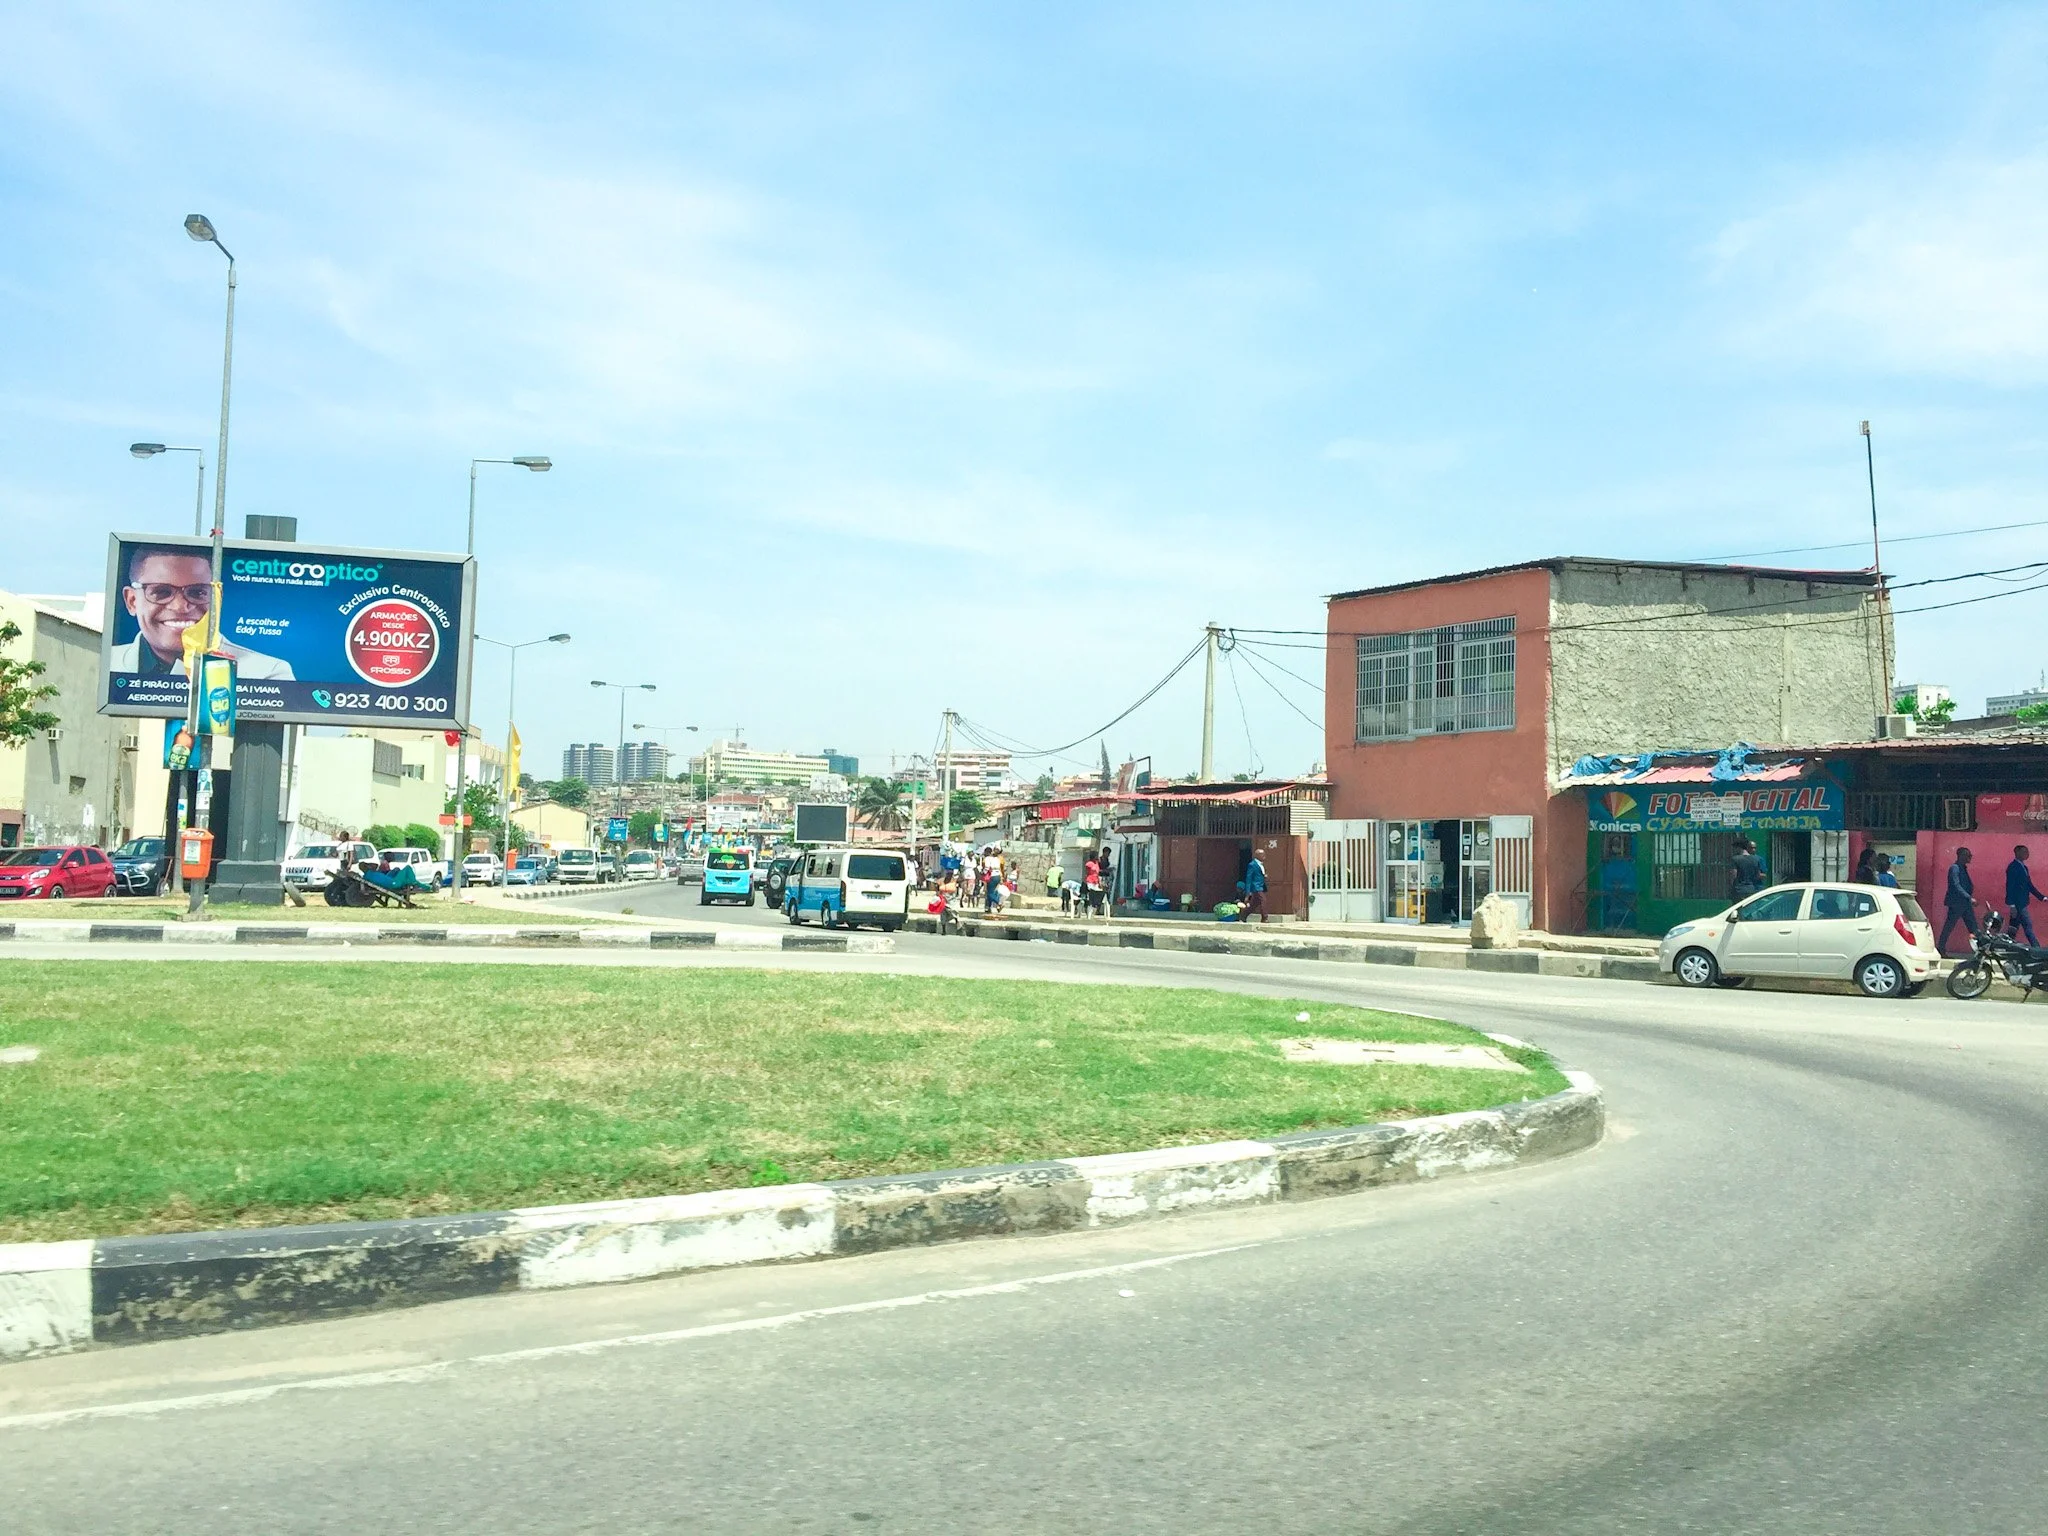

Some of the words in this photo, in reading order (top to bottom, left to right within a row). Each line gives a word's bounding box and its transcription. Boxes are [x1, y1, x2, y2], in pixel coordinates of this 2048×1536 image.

[232, 574, 250, 582] Você
[338, 586, 389, 615] Exclusivo
[392, 584, 450, 628] Centrooptico
[237, 616, 244, 624] A
[245, 618, 277, 626] escolha
[279, 619, 289, 627] de
[370, 612, 418, 621] ARMAÇÕES
[236, 626, 256, 635] Eddy
[354, 630, 430, 649] 4.900KZ
[128, 679, 141, 687] ZÉ
[142, 680, 170, 689] PIRÃO
[253, 686, 281, 694] VIANA
[127, 693, 183, 703] AEROPORTO
[240, 698, 284, 707] CACUACO
[334, 692, 370, 708] 923
[375, 695, 409, 710] 400
[413, 697, 448, 713] 300
[237, 711, 275, 719] JCDecaux
[1589, 820, 1642, 832] Konica
